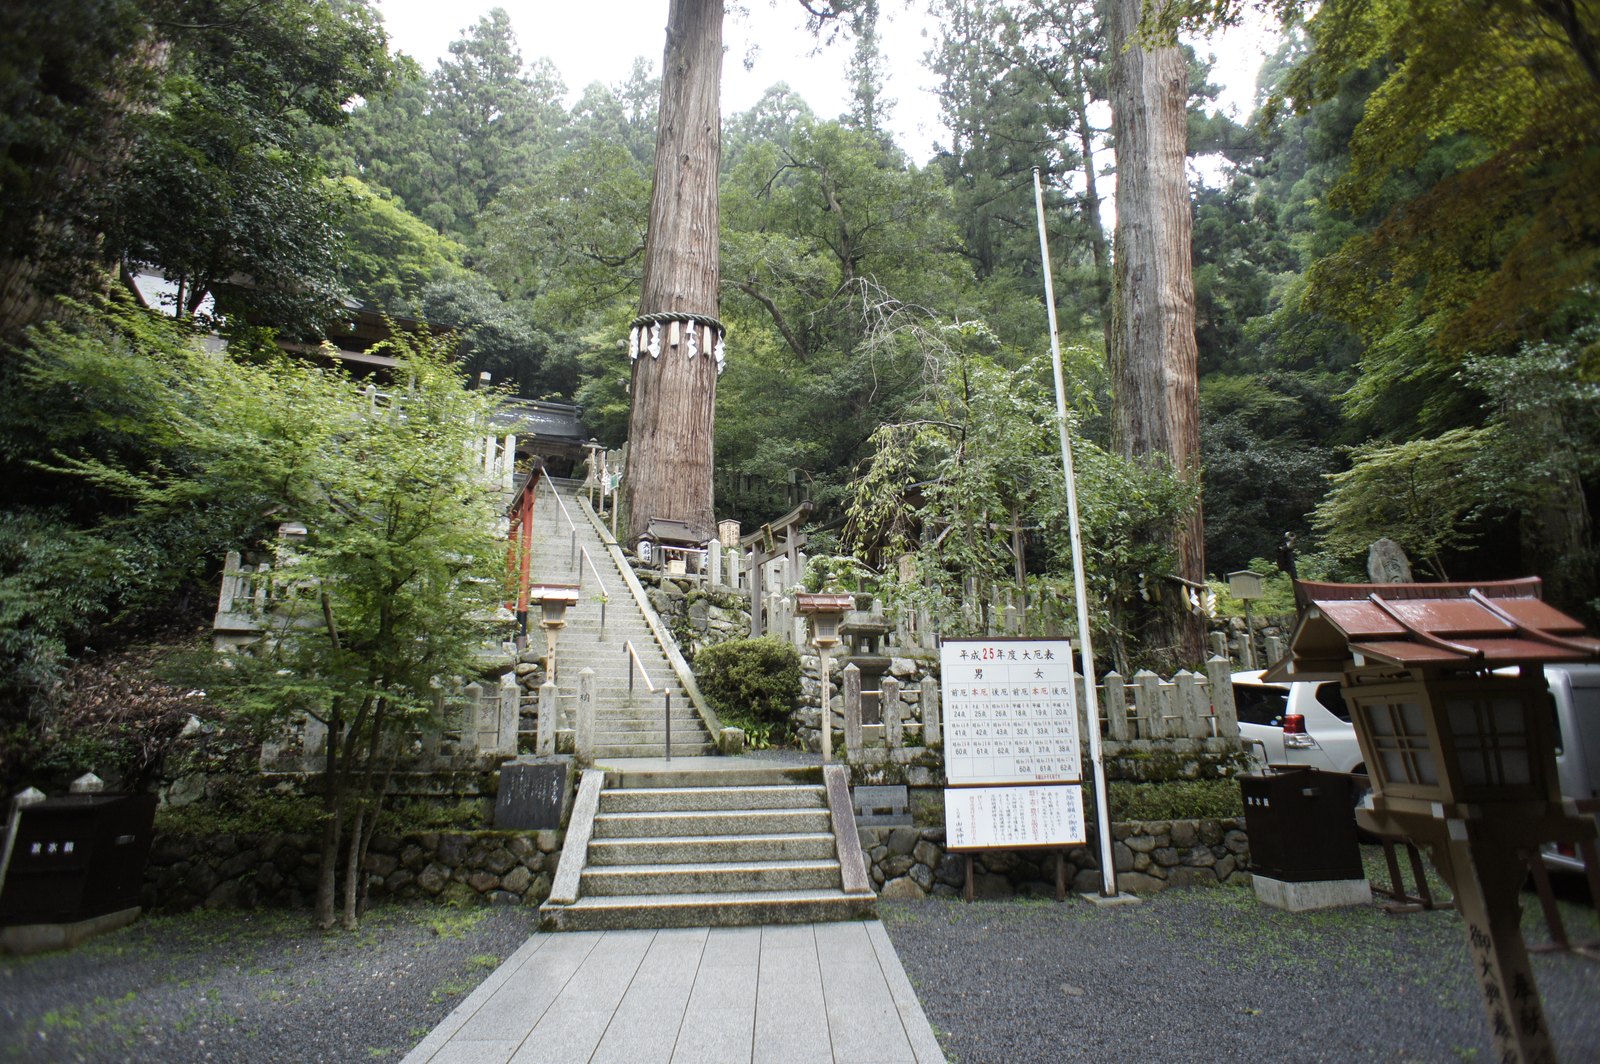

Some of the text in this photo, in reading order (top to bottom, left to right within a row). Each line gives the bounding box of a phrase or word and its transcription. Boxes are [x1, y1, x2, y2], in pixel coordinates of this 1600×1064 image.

[643, 542, 651, 561] 大杉社
[960, 648, 1055, 660] 平成25年度 大厄表
[974, 668, 983, 679] 男
[1034, 668, 1044, 679] 女
[951, 687, 1068, 697] 前厄 本厄 後厄 前厄 本厄 後厄
